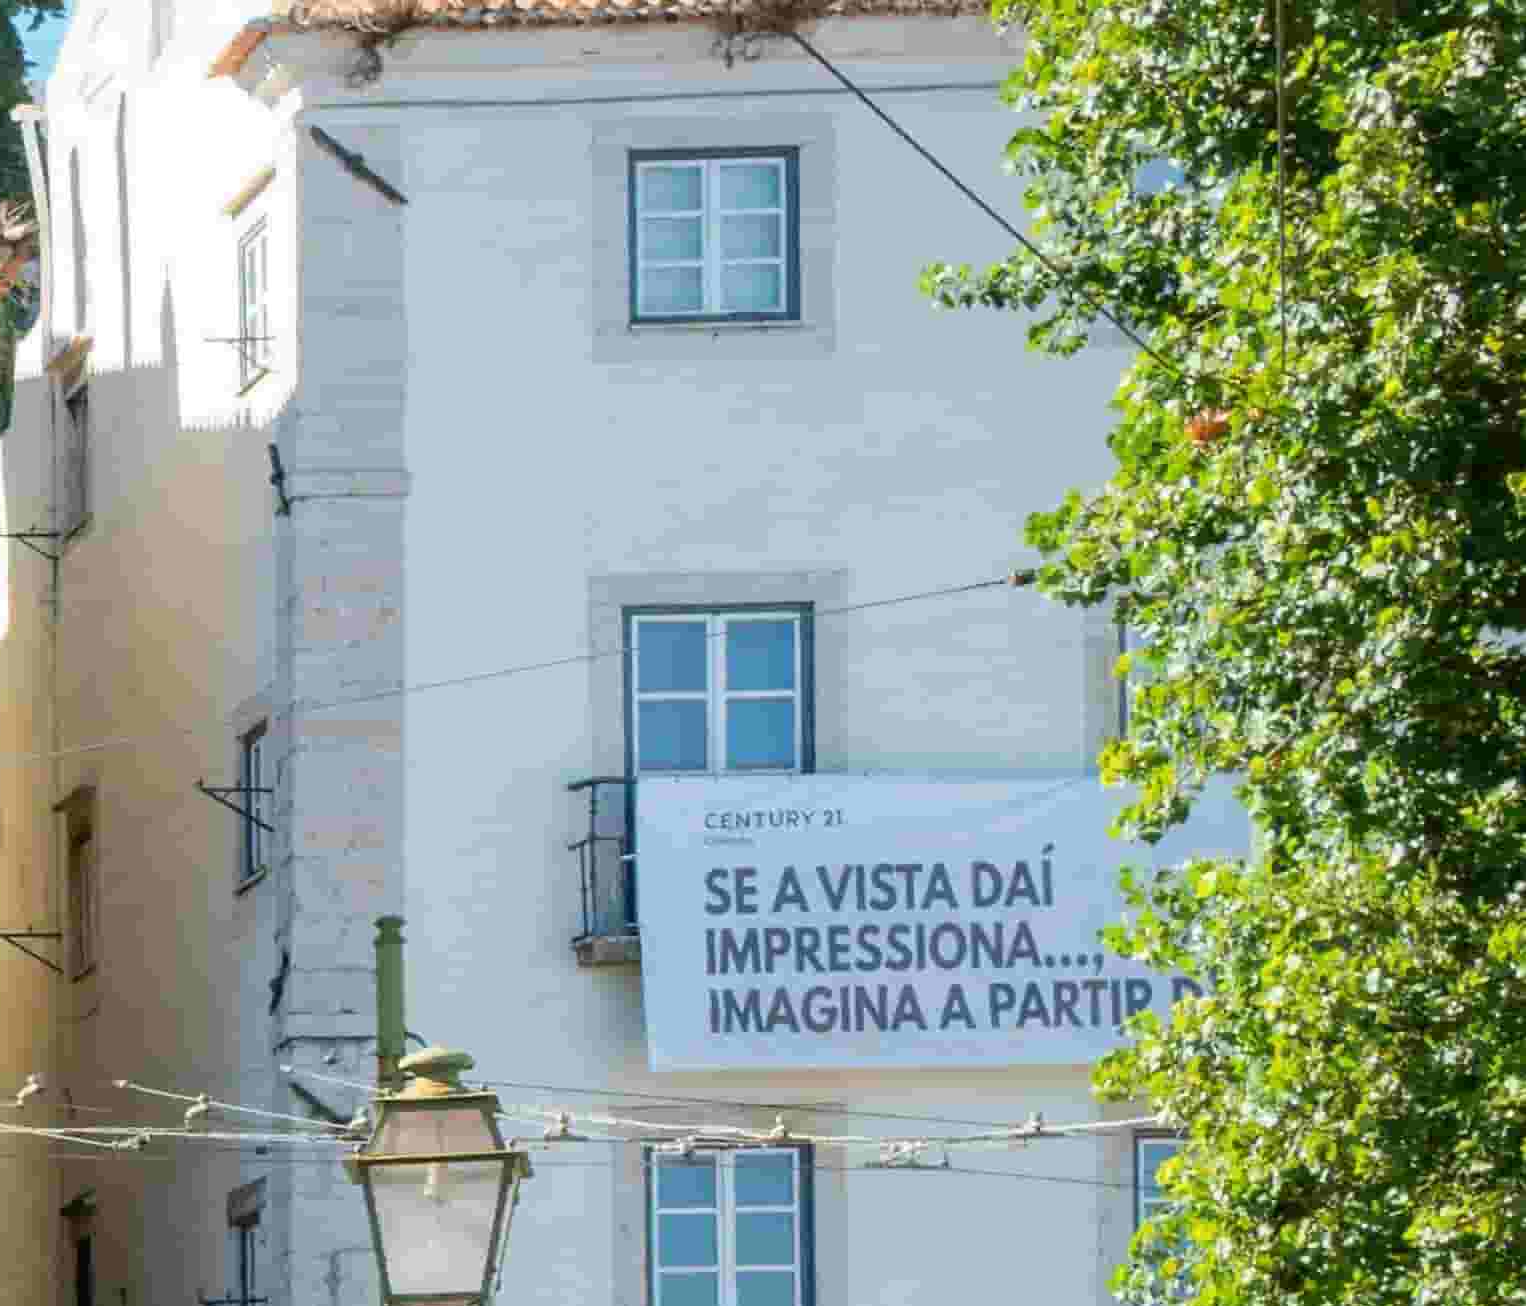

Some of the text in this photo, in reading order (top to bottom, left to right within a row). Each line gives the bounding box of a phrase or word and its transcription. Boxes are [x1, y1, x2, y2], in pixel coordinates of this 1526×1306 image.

[704, 808, 843, 830] CENTURY 21
[704, 843, 1056, 916] SE A VISTA DAÍ
[704, 921, 1105, 975] IMPRESSIONA...,
[708, 983, 928, 1034] IMAGINA
[938, 983, 976, 1031] A
